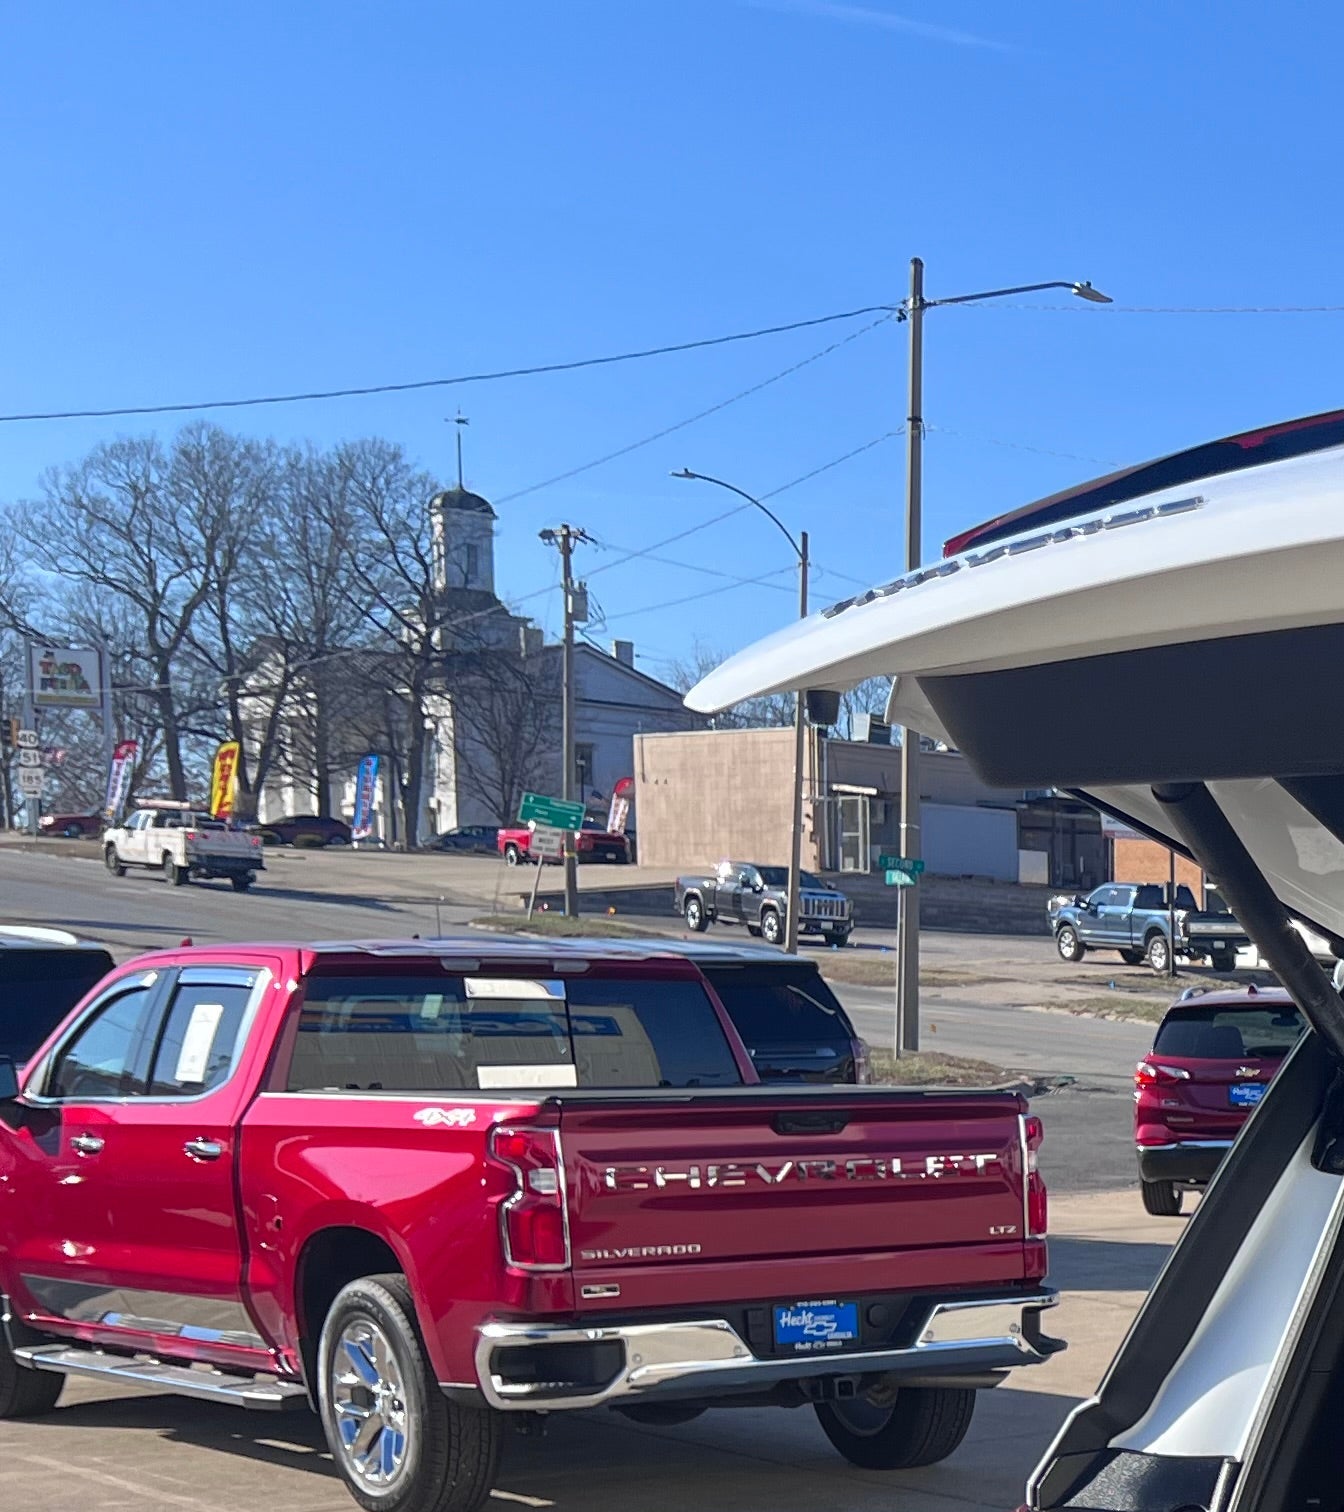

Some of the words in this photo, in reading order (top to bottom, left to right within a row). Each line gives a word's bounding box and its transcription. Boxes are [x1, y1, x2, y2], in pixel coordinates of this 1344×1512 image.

[20, 733, 37, 745] 40
[22, 753, 38, 764] 51
[605, 1153, 998, 1189] CHEVROLET
[989, 1225, 1017, 1235] LTZ
[581, 1244, 701, 1259] SILVERADO
[780, 1310, 814, 1328] Hecht
